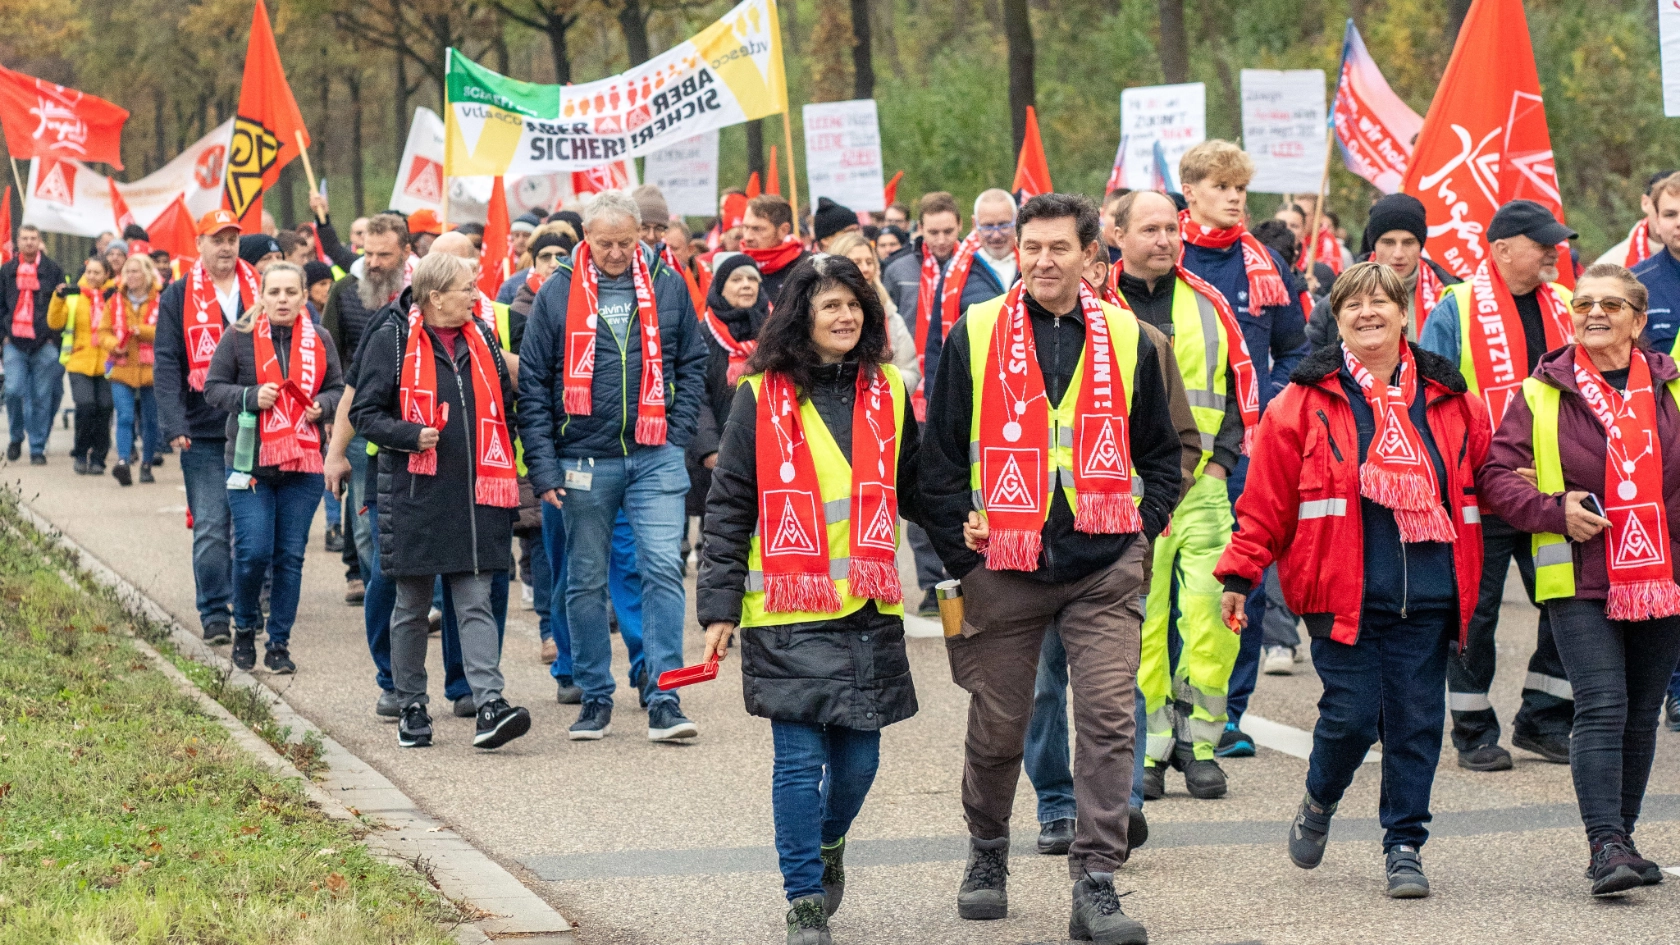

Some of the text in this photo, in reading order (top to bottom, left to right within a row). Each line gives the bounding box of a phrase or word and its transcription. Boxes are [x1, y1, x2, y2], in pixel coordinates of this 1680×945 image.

[530, 136, 627, 161] SICHER!
[1443, 246, 1477, 281] BAY
[1477, 311, 1515, 384] JETZT!
